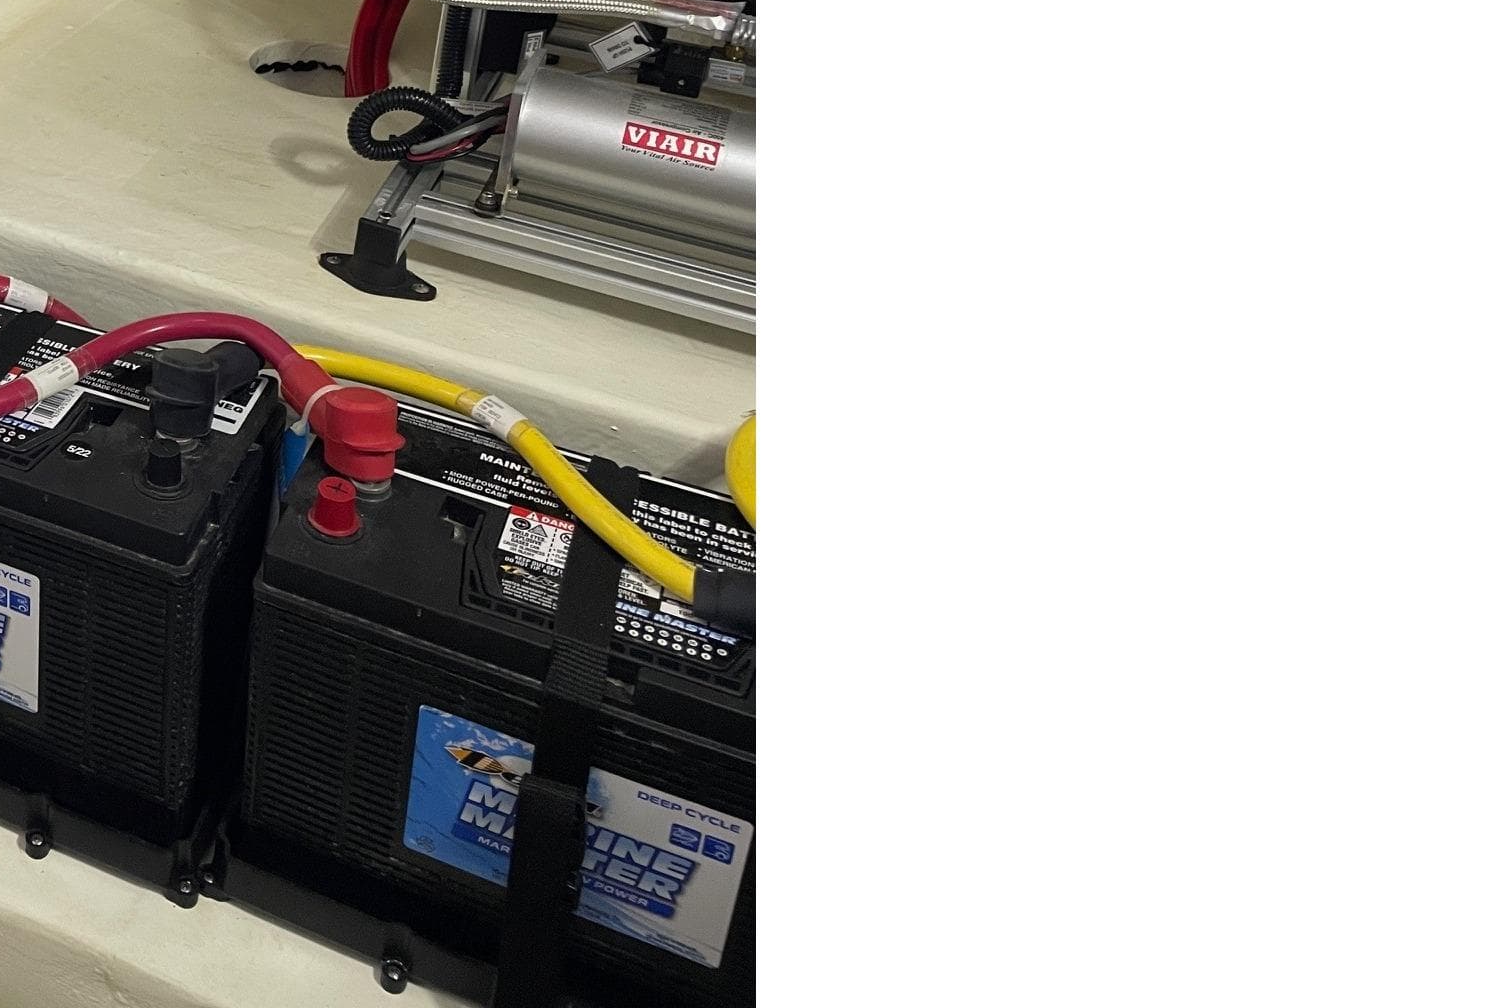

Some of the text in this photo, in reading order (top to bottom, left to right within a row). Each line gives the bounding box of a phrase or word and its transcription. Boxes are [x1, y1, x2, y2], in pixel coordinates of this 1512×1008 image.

[621, 144, 716, 173] Your Vital Air Source
[627, 124, 718, 163] VIAIR
[36, 344, 61, 357] label
[94, 381, 112, 392] MADE
[111, 384, 151, 403] RELIABILITY
[97, 377, 142, 394] RESISTANCE
[216, 401, 244, 415] NEG
[66, 443, 93, 459] 5/22
[479, 452, 752, 540] MAINT ESSIBLE BAT
[447, 476, 484, 492] RUGGED
[484, 487, 509, 500] CASE
[702, 554, 752, 573] AMERICAN
[449, 469, 475, 483] MORE
[475, 478, 560, 509] POWER-PER-POUND
[704, 548, 756, 569] VIBRATION
[493, 473, 520, 488] fluid
[643, 518, 668, 532] has
[669, 527, 703, 543] been
[706, 537, 720, 547] in
[721, 543, 756, 558] servi
[541, 513, 576, 532] DANG
[631, 509, 656, 522] this
[658, 517, 692, 532] label
[694, 527, 709, 537] to
[711, 533, 753, 550] check
[653, 611, 738, 646] MASTER
[637, 790, 743, 835] DEEP CYCLE
[477, 835, 511, 856] MAR
[593, 880, 650, 908] POWER
